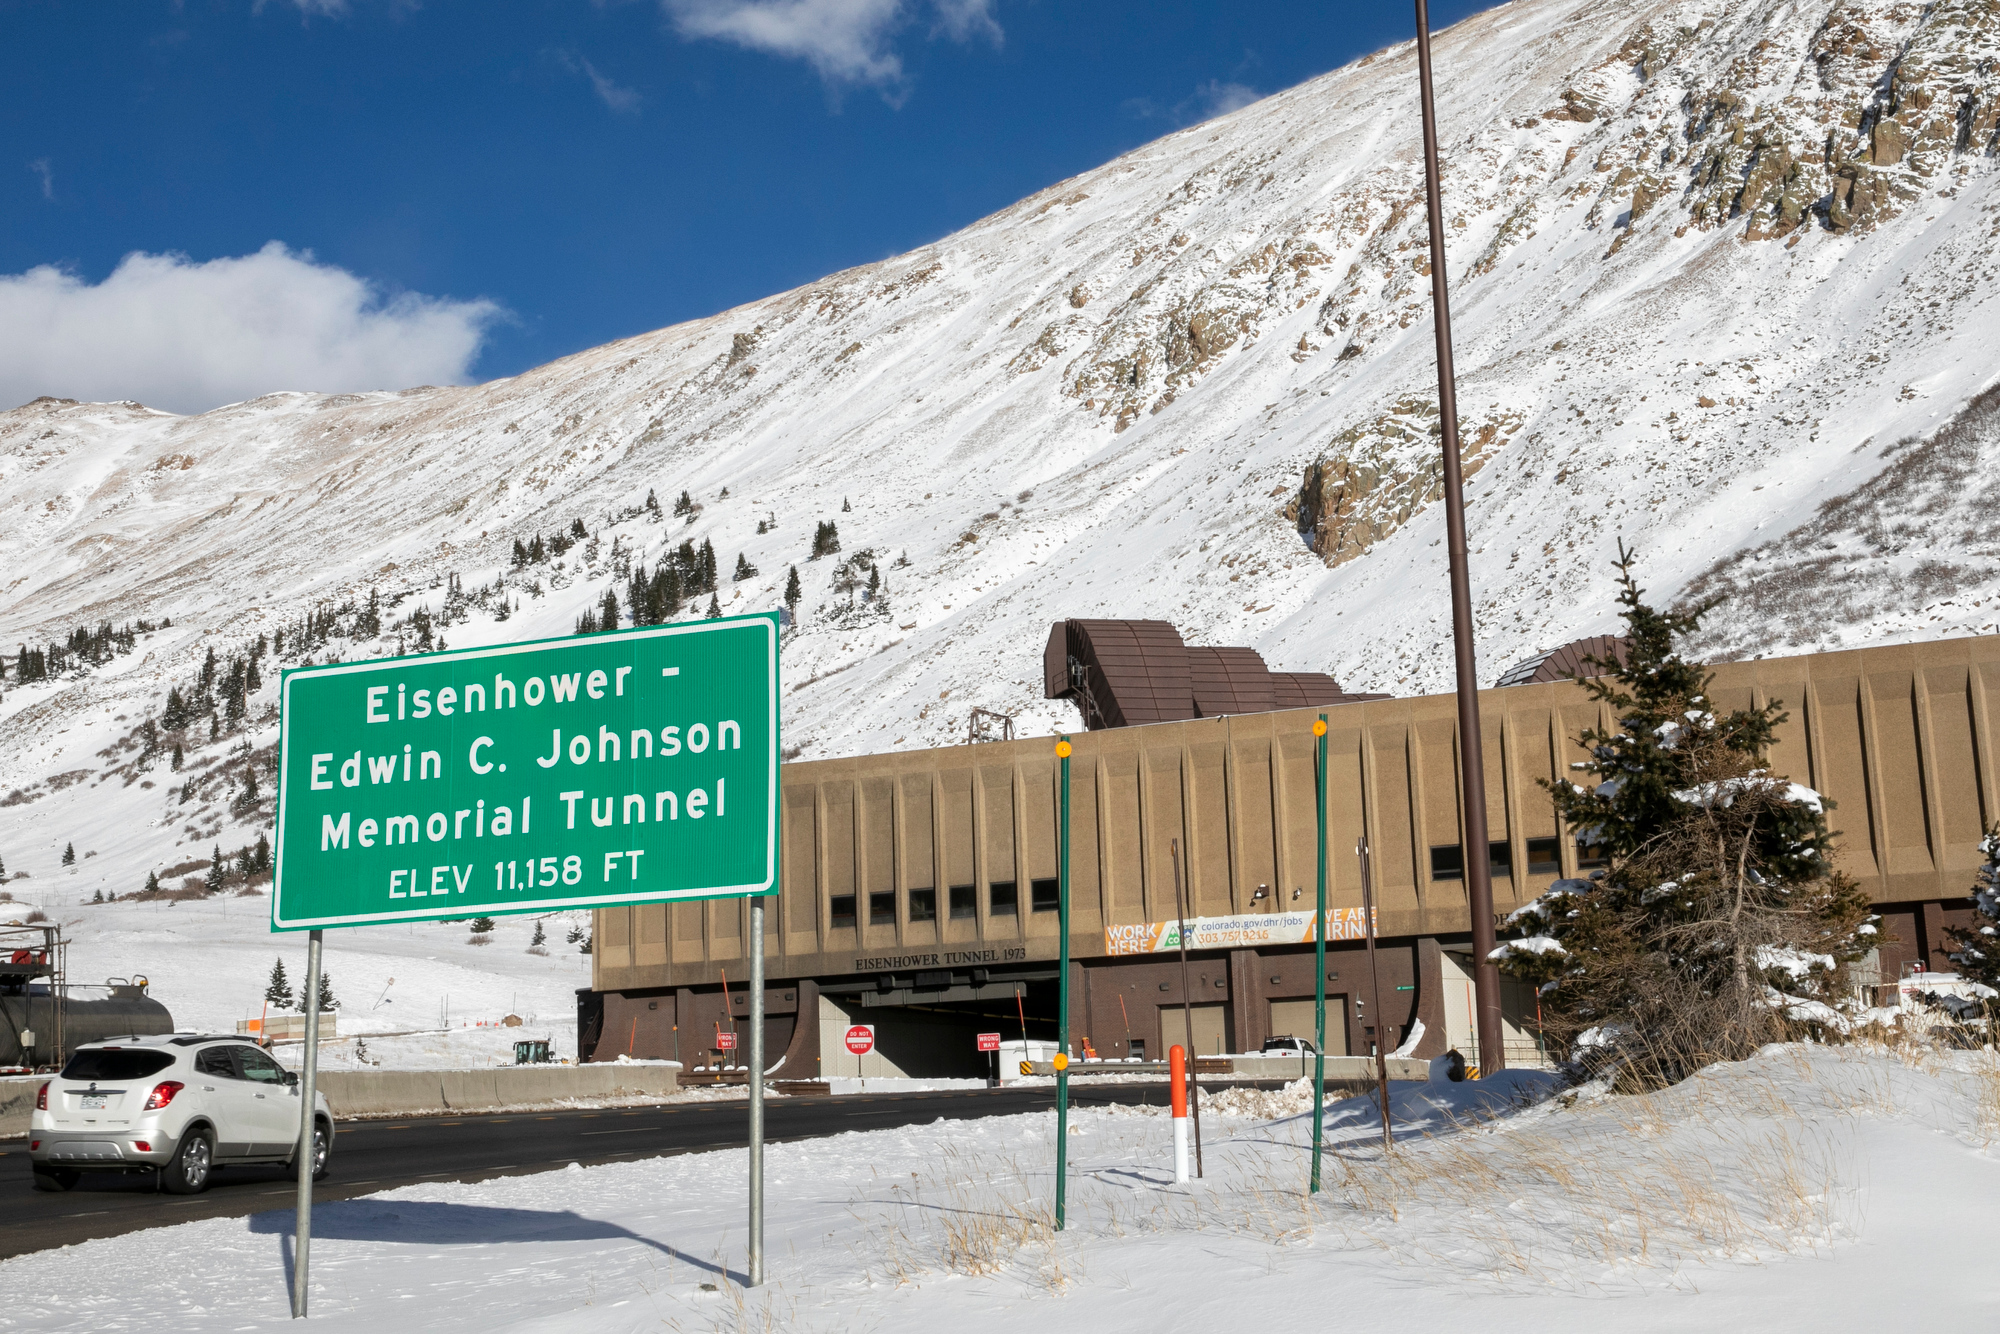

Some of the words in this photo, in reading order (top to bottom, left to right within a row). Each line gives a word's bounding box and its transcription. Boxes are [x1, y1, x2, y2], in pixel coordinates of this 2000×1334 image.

[366, 665, 633, 724] Eisenhower
[310, 743, 442, 791] Edwin
[468, 735, 507, 775] C.
[536, 717, 741, 769] Johnson
[320, 795, 531, 852] Memorial
[559, 777, 725, 830] Tunnel
[388, 863, 474, 899] ELEV
[494, 854, 583, 893] 11,158
[603, 849, 645, 882] FT
[1107, 922, 1157, 941] WORK
[1201, 916, 1303, 931] colorado.gov/dhr/jobs
[1108, 938, 1149, 955] HERE
[1168, 936, 1180, 945] CO
[856, 953, 940, 971] EISENHOWER
[944, 950, 1000, 965] TUNNEL
[1003, 947, 1026, 961] 1973
